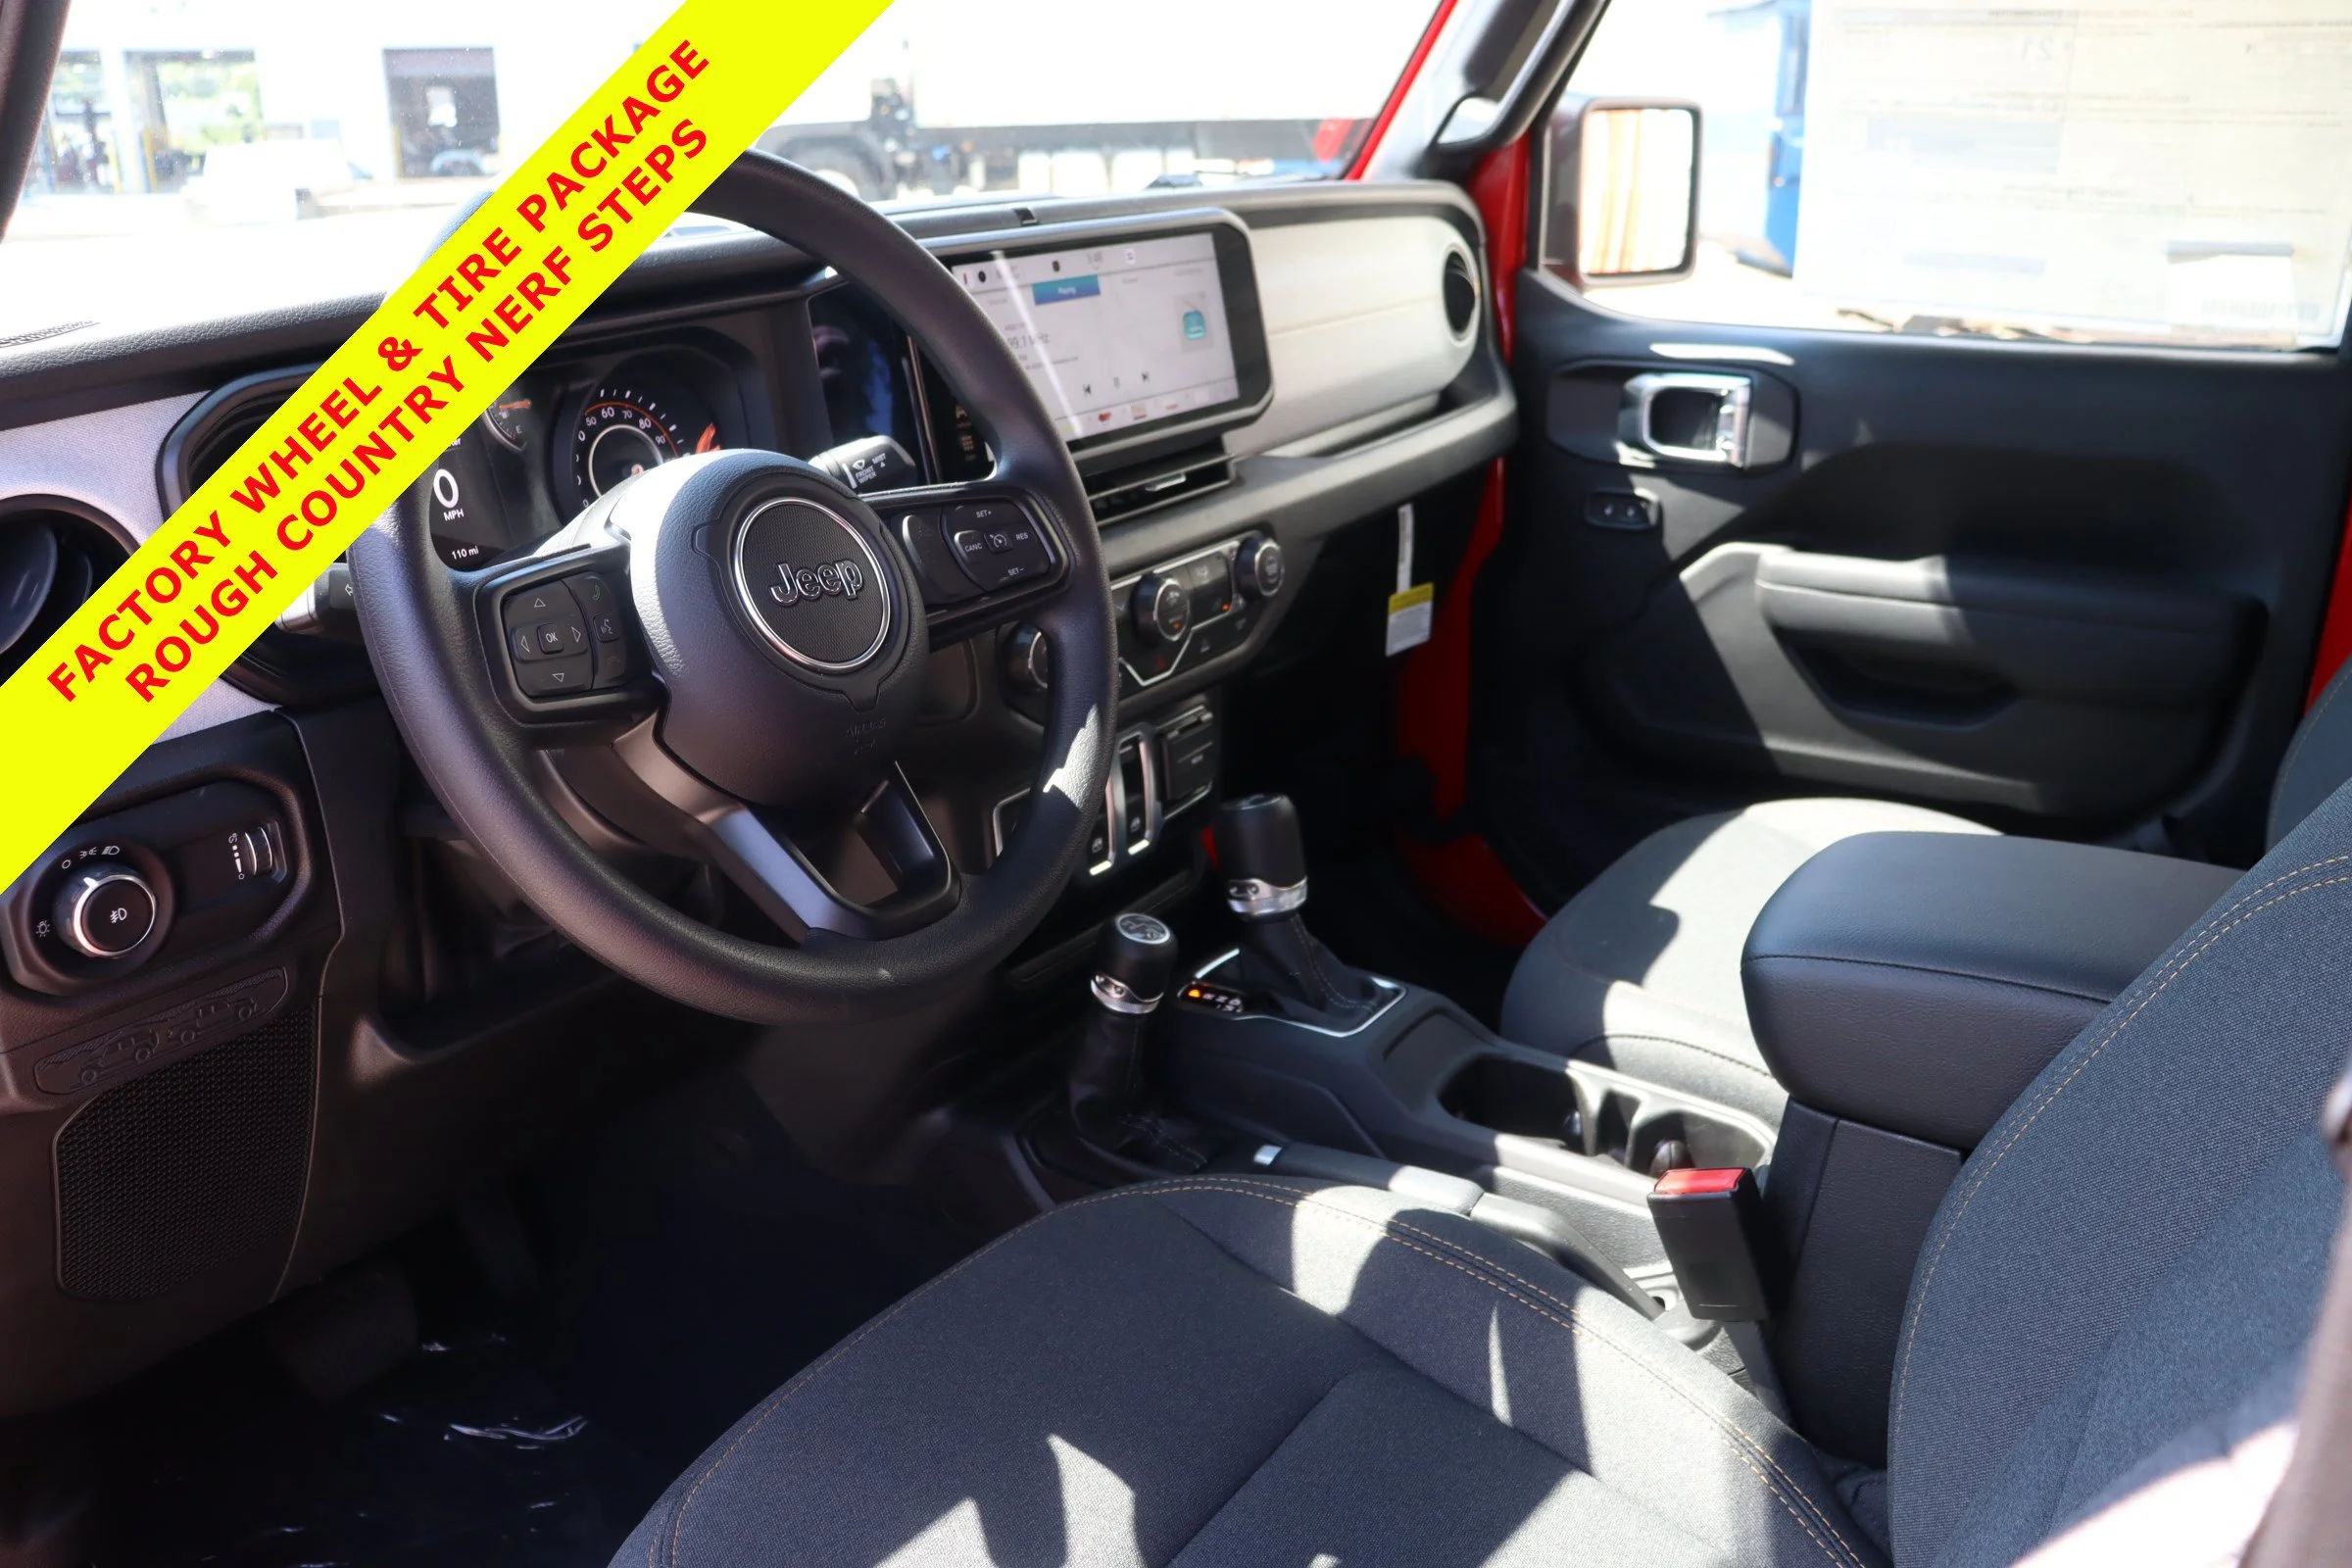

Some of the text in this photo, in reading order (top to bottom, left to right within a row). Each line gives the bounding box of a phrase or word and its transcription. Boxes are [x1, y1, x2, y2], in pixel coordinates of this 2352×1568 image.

[601, 406, 615, 418] 60
[622, 410, 633, 419] 70
[585, 416, 597, 426] 50
[638, 417, 652, 429] 80
[655, 435, 665, 445] 90
[432, 468, 460, 509] 0
[443, 509, 465, 521] MPH
[1015, 532, 1029, 541] RES
[451, 545, 479, 561] 110 mi
[964, 542, 983, 553] CANC
[770, 558, 863, 607] Jeep
[545, 632, 559, 643] OK
